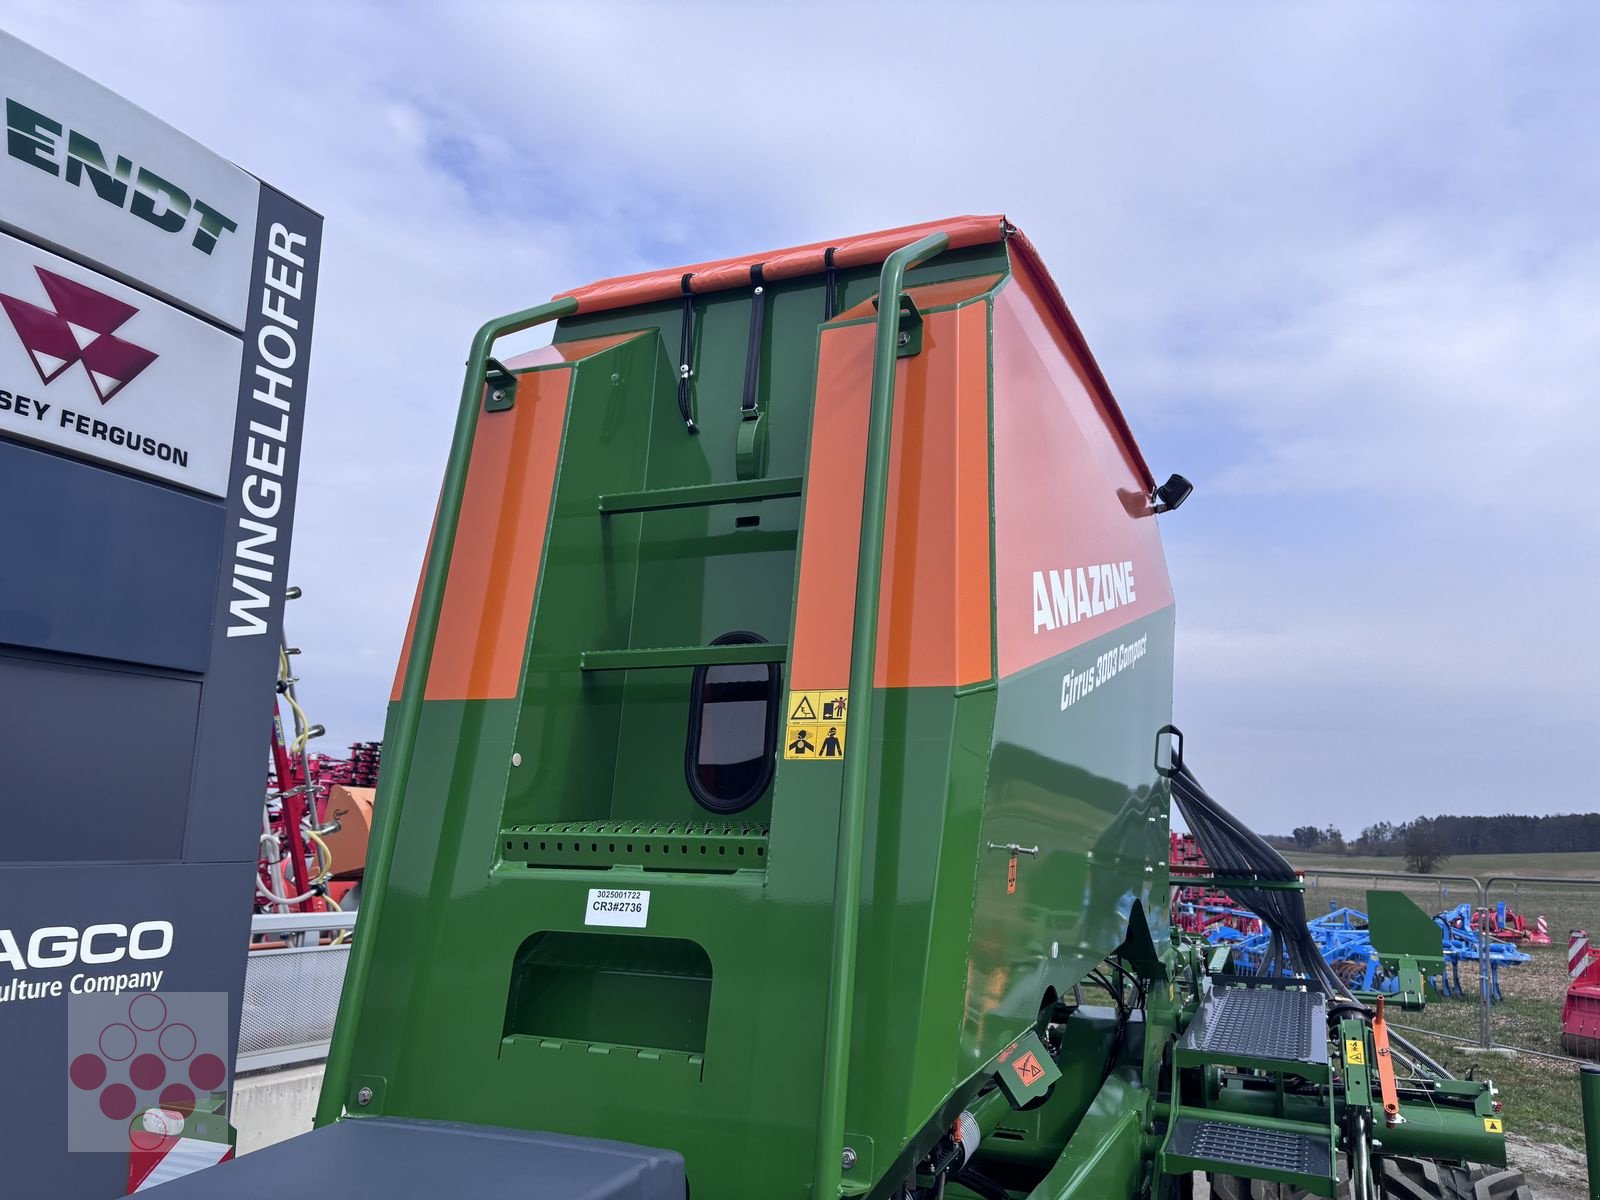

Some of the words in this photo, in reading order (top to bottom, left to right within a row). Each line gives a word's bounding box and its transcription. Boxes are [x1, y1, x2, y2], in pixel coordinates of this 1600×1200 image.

[60, 409, 188, 468] FERGUSON
[227, 221, 307, 638] WINGELHOFER
[1033, 561, 1136, 634] AMAZONE
[1061, 666, 1095, 711] Cirrus
[1096, 647, 1118, 688] 3003
[1118, 632, 1147, 670] Compact
[593, 901, 642, 912] CR3#2736
[597, 890, 641, 899] 3025001722
[0, 920, 173, 970] AGCO
[70, 970, 163, 996] Company
